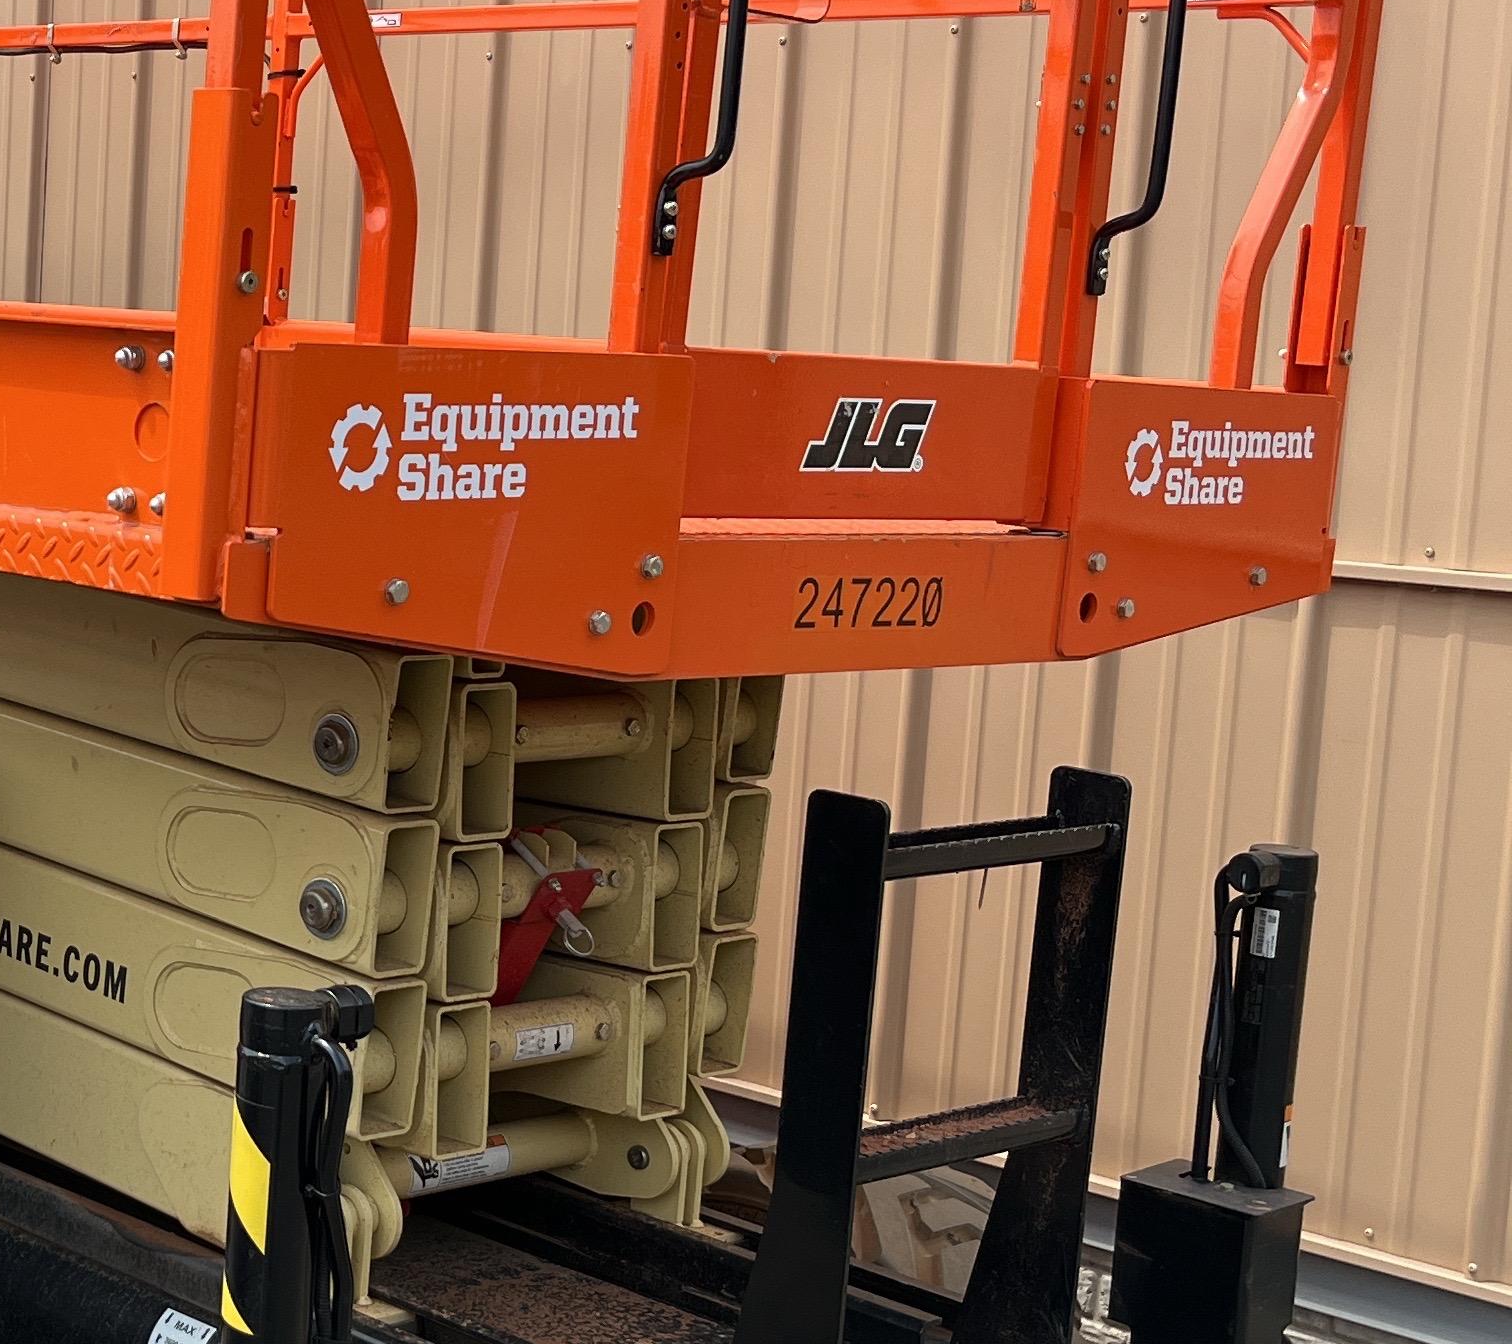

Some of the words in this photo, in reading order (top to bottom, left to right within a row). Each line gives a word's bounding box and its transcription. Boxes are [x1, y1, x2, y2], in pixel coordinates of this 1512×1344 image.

[400, 392, 640, 452] Equipment
[800, 398, 937, 471] JLG
[1167, 420, 1316, 468] Equipment
[396, 453, 528, 501] Share
[1163, 467, 1244, 505] Share
[793, 576, 944, 629] 247220
[174, 1320, 197, 1337] MAX
